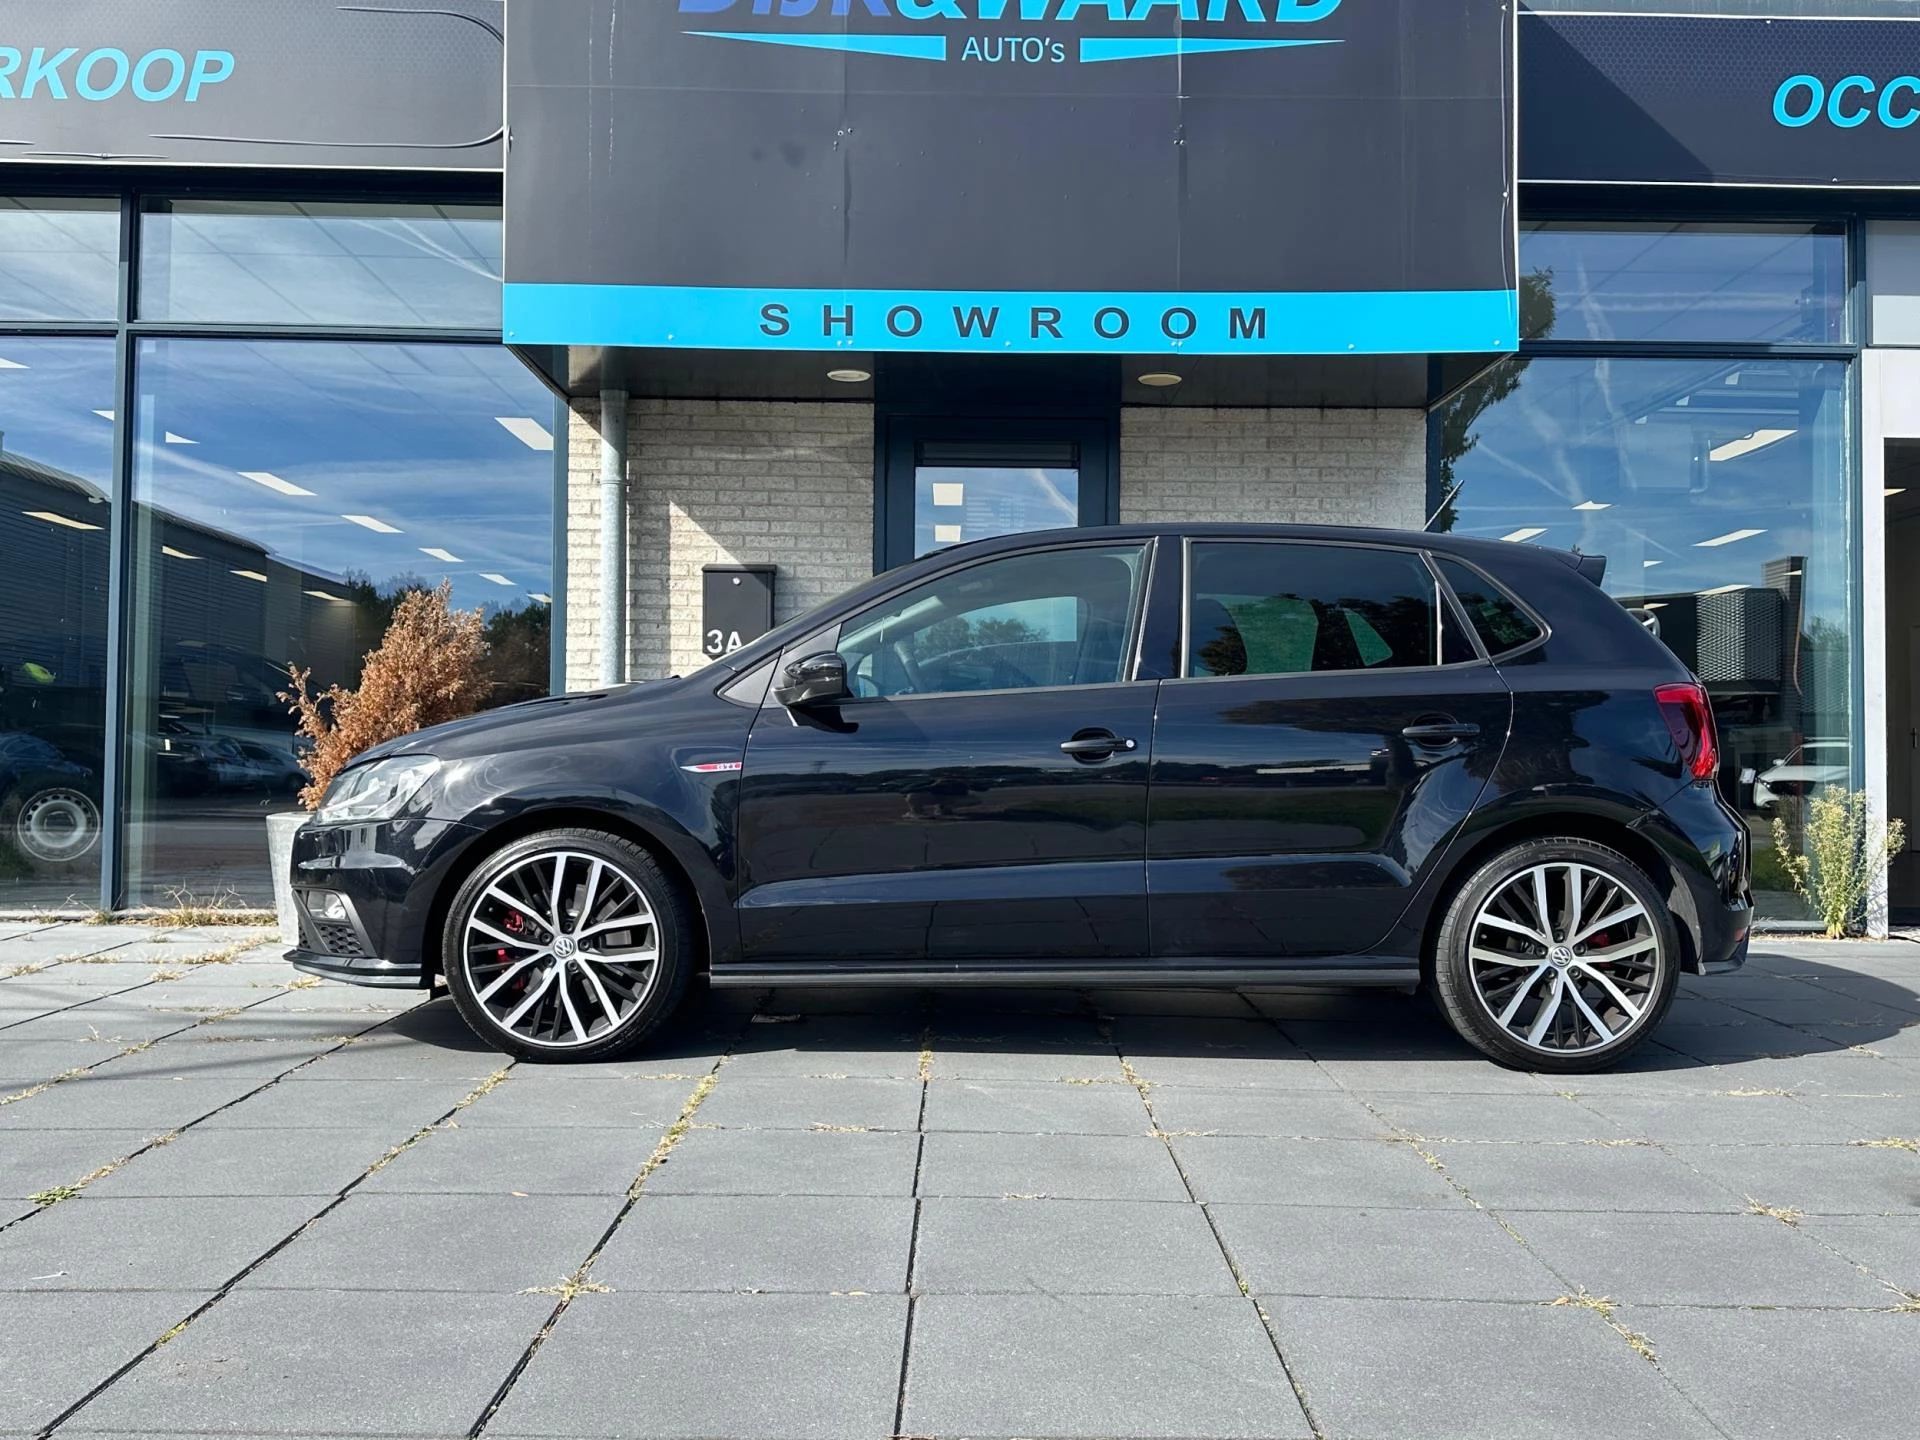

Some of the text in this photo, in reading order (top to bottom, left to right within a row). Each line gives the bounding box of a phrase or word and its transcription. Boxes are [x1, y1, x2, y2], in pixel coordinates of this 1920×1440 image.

[961, 36, 1066, 63] AUTO's
[759, 303, 1266, 340] SHOWROOM
[706, 629, 742, 654] 3A
